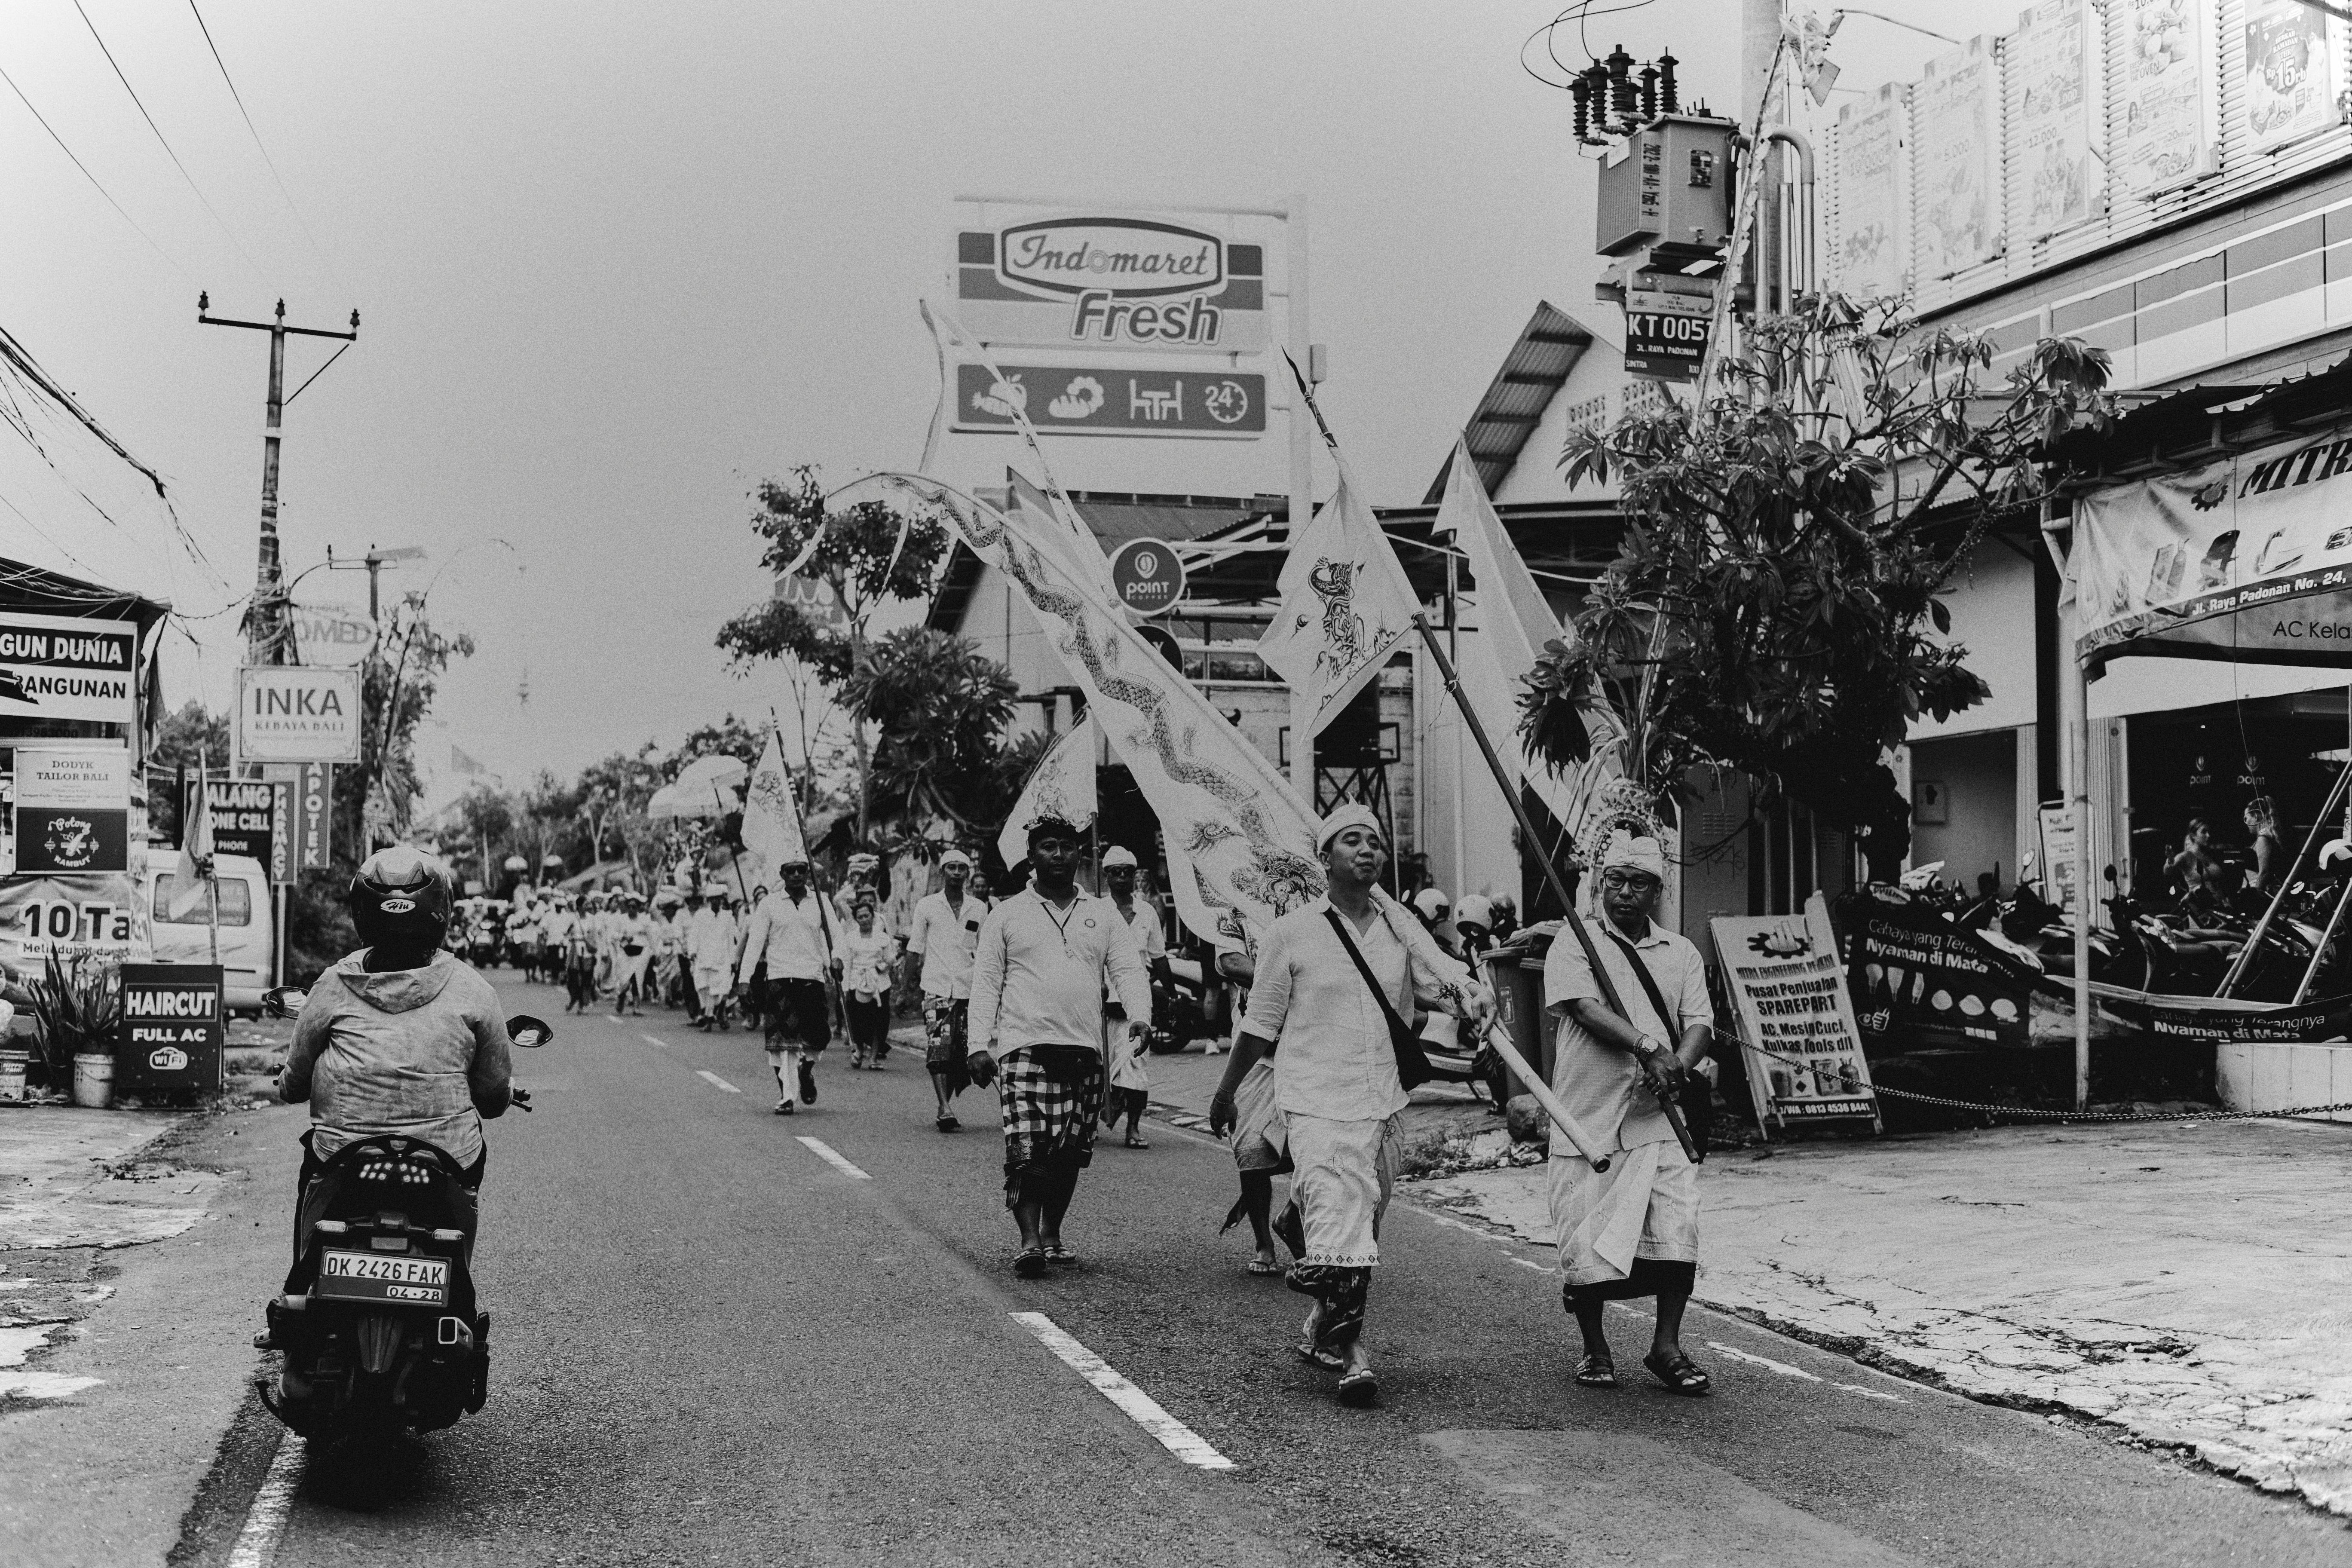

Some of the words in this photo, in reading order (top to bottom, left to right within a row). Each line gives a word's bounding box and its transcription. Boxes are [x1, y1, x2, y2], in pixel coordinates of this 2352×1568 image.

[2273, 37, 2298, 53] RAMADAN
[1014, 234, 1209, 275] Indomaret
[1073, 292, 1220, 343] Fresh
[1667, 346, 1698, 356] PADONAN
[2237, 438, 2352, 499] MITR
[2210, 596, 2236, 611] Raya
[2239, 583, 2291, 603] Padonan
[2295, 577, 2317, 591] No.
[2322, 571, 2346, 586] 24,
[2273, 621, 2303, 637] AC
[54, 637, 123, 665] DUNIA
[256, 688, 342, 715] INKA
[52, 760, 94, 769] DODYK
[36, 772, 79, 781] TAILOR
[83, 773, 109, 781] BALI
[238, 812, 270, 831] CELL
[54, 854, 91, 867] RAMBUT
[25, 904, 71, 938] 10
[1912, 932, 1942, 949] yang
[1866, 938, 1927, 963] Nyaman
[1929, 950, 1942, 965] di
[1945, 953, 1988, 974] Mata
[1744, 984, 1779, 998] Pusat
[1779, 977, 1839, 996] Penjualan
[127, 991, 215, 1017] HAIRCUT
[1757, 994, 1838, 1016] SPAREPART
[132, 1028, 177, 1042] FULL
[180, 1028, 207, 1042] AC
[2233, 1028, 2251, 1039] di
[1804, 1038, 1835, 1053] Tools
[1837, 1036, 1853, 1051] dll
[327, 1257, 352, 1276] DK
[356, 1259, 402, 1280] 2426
[407, 1264, 443, 1284] FAK
